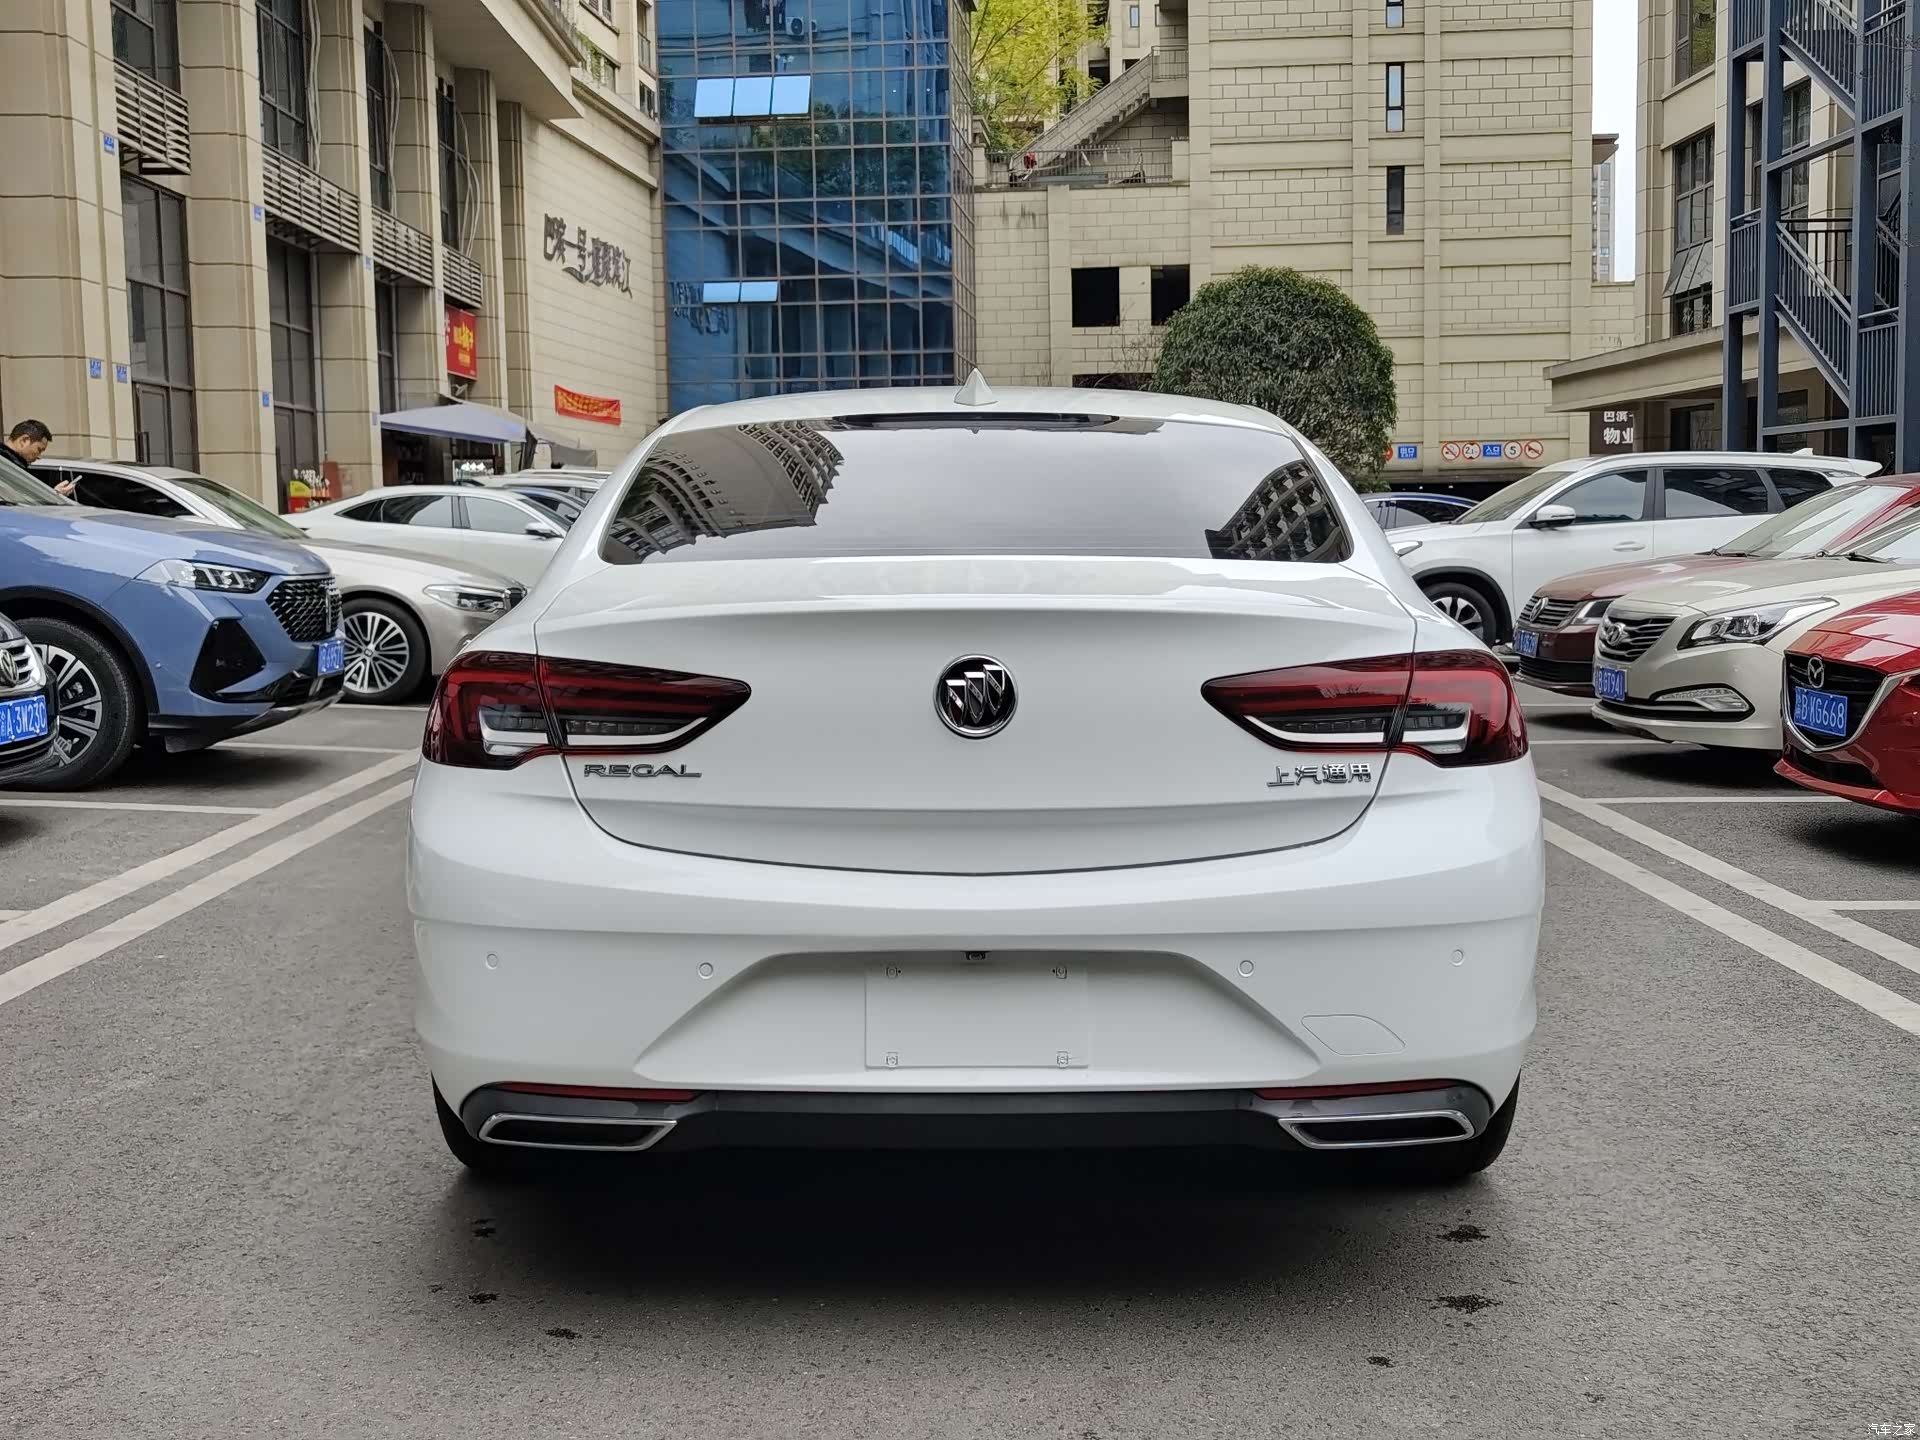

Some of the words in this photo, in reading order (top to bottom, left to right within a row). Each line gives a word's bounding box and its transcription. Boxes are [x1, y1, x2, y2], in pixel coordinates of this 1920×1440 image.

[1604, 427, 1634, 445] 物业
[1509, 446, 1517, 456] 5
[584, 763, 702, 778] REGAL
[1266, 763, 1372, 788] 上汽通用
